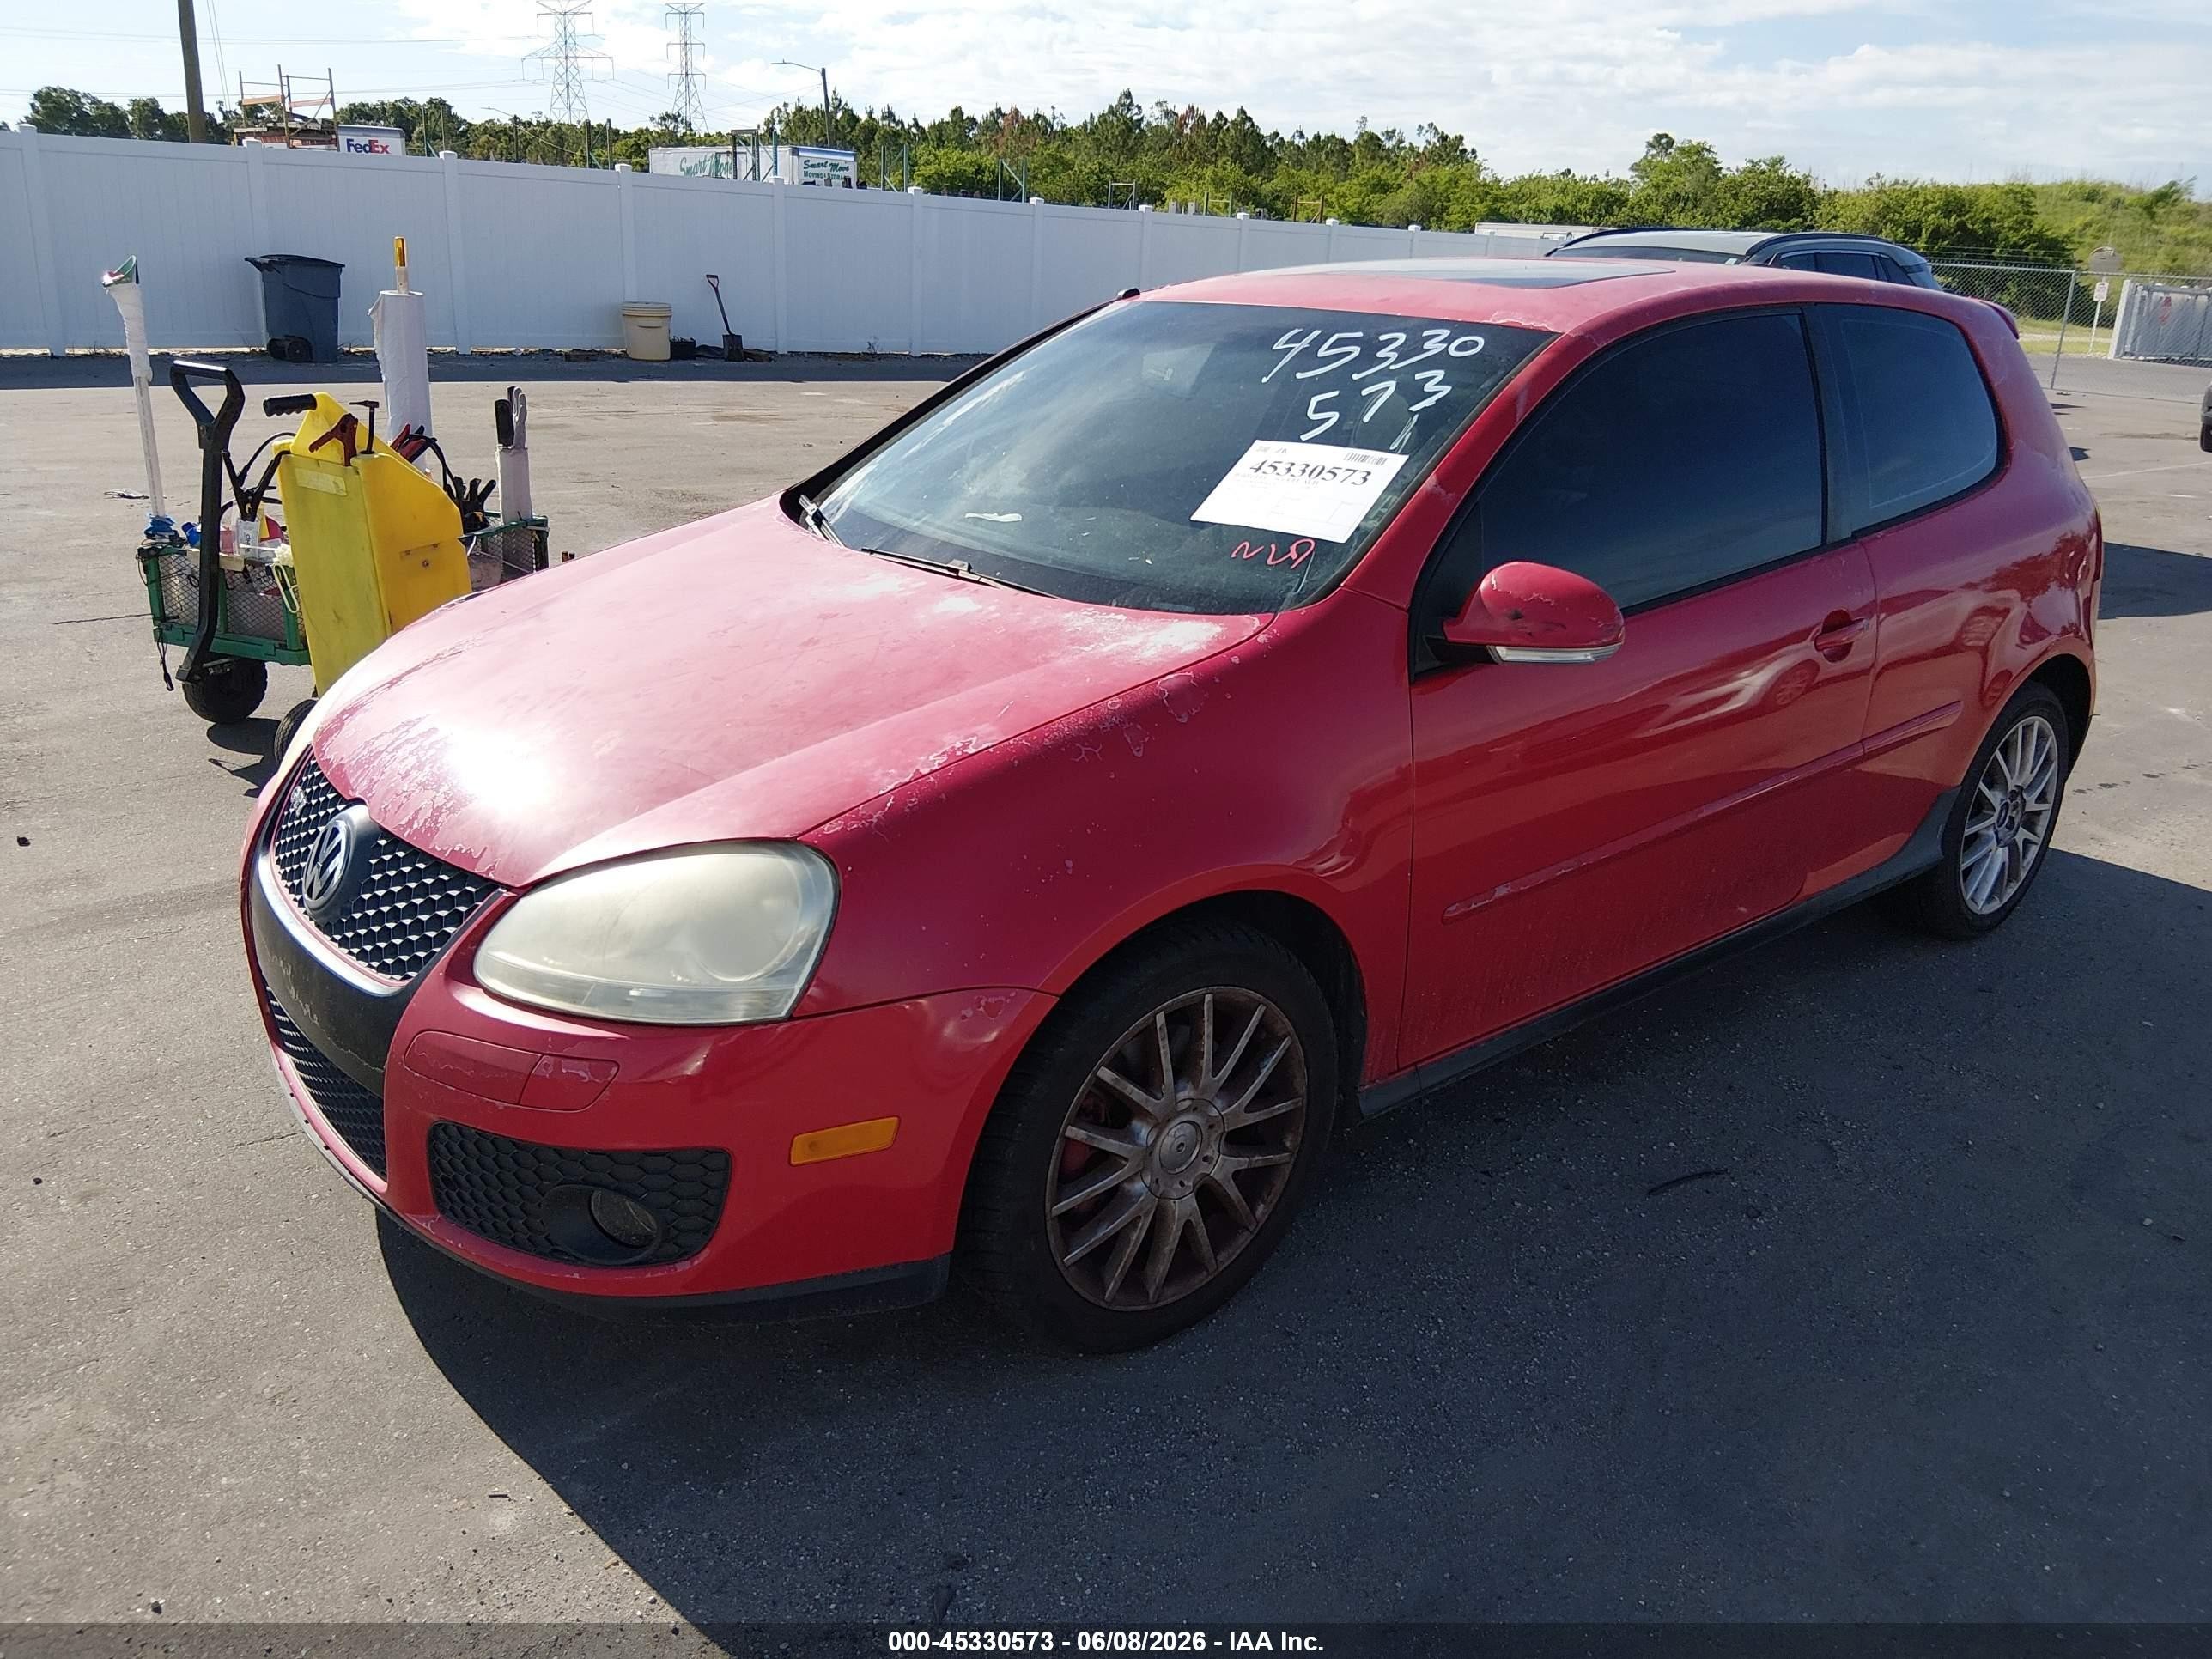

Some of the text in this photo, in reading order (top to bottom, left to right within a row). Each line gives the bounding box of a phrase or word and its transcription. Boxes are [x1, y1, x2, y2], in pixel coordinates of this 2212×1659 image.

[346, 138, 391, 154] FedEx
[679, 153, 710, 177] Smart
[804, 159, 850, 173] Smart Move
[1261, 328, 1485, 383] 45330
[1299, 369, 1453, 441] 573
[1250, 459, 1372, 486] 45330573
